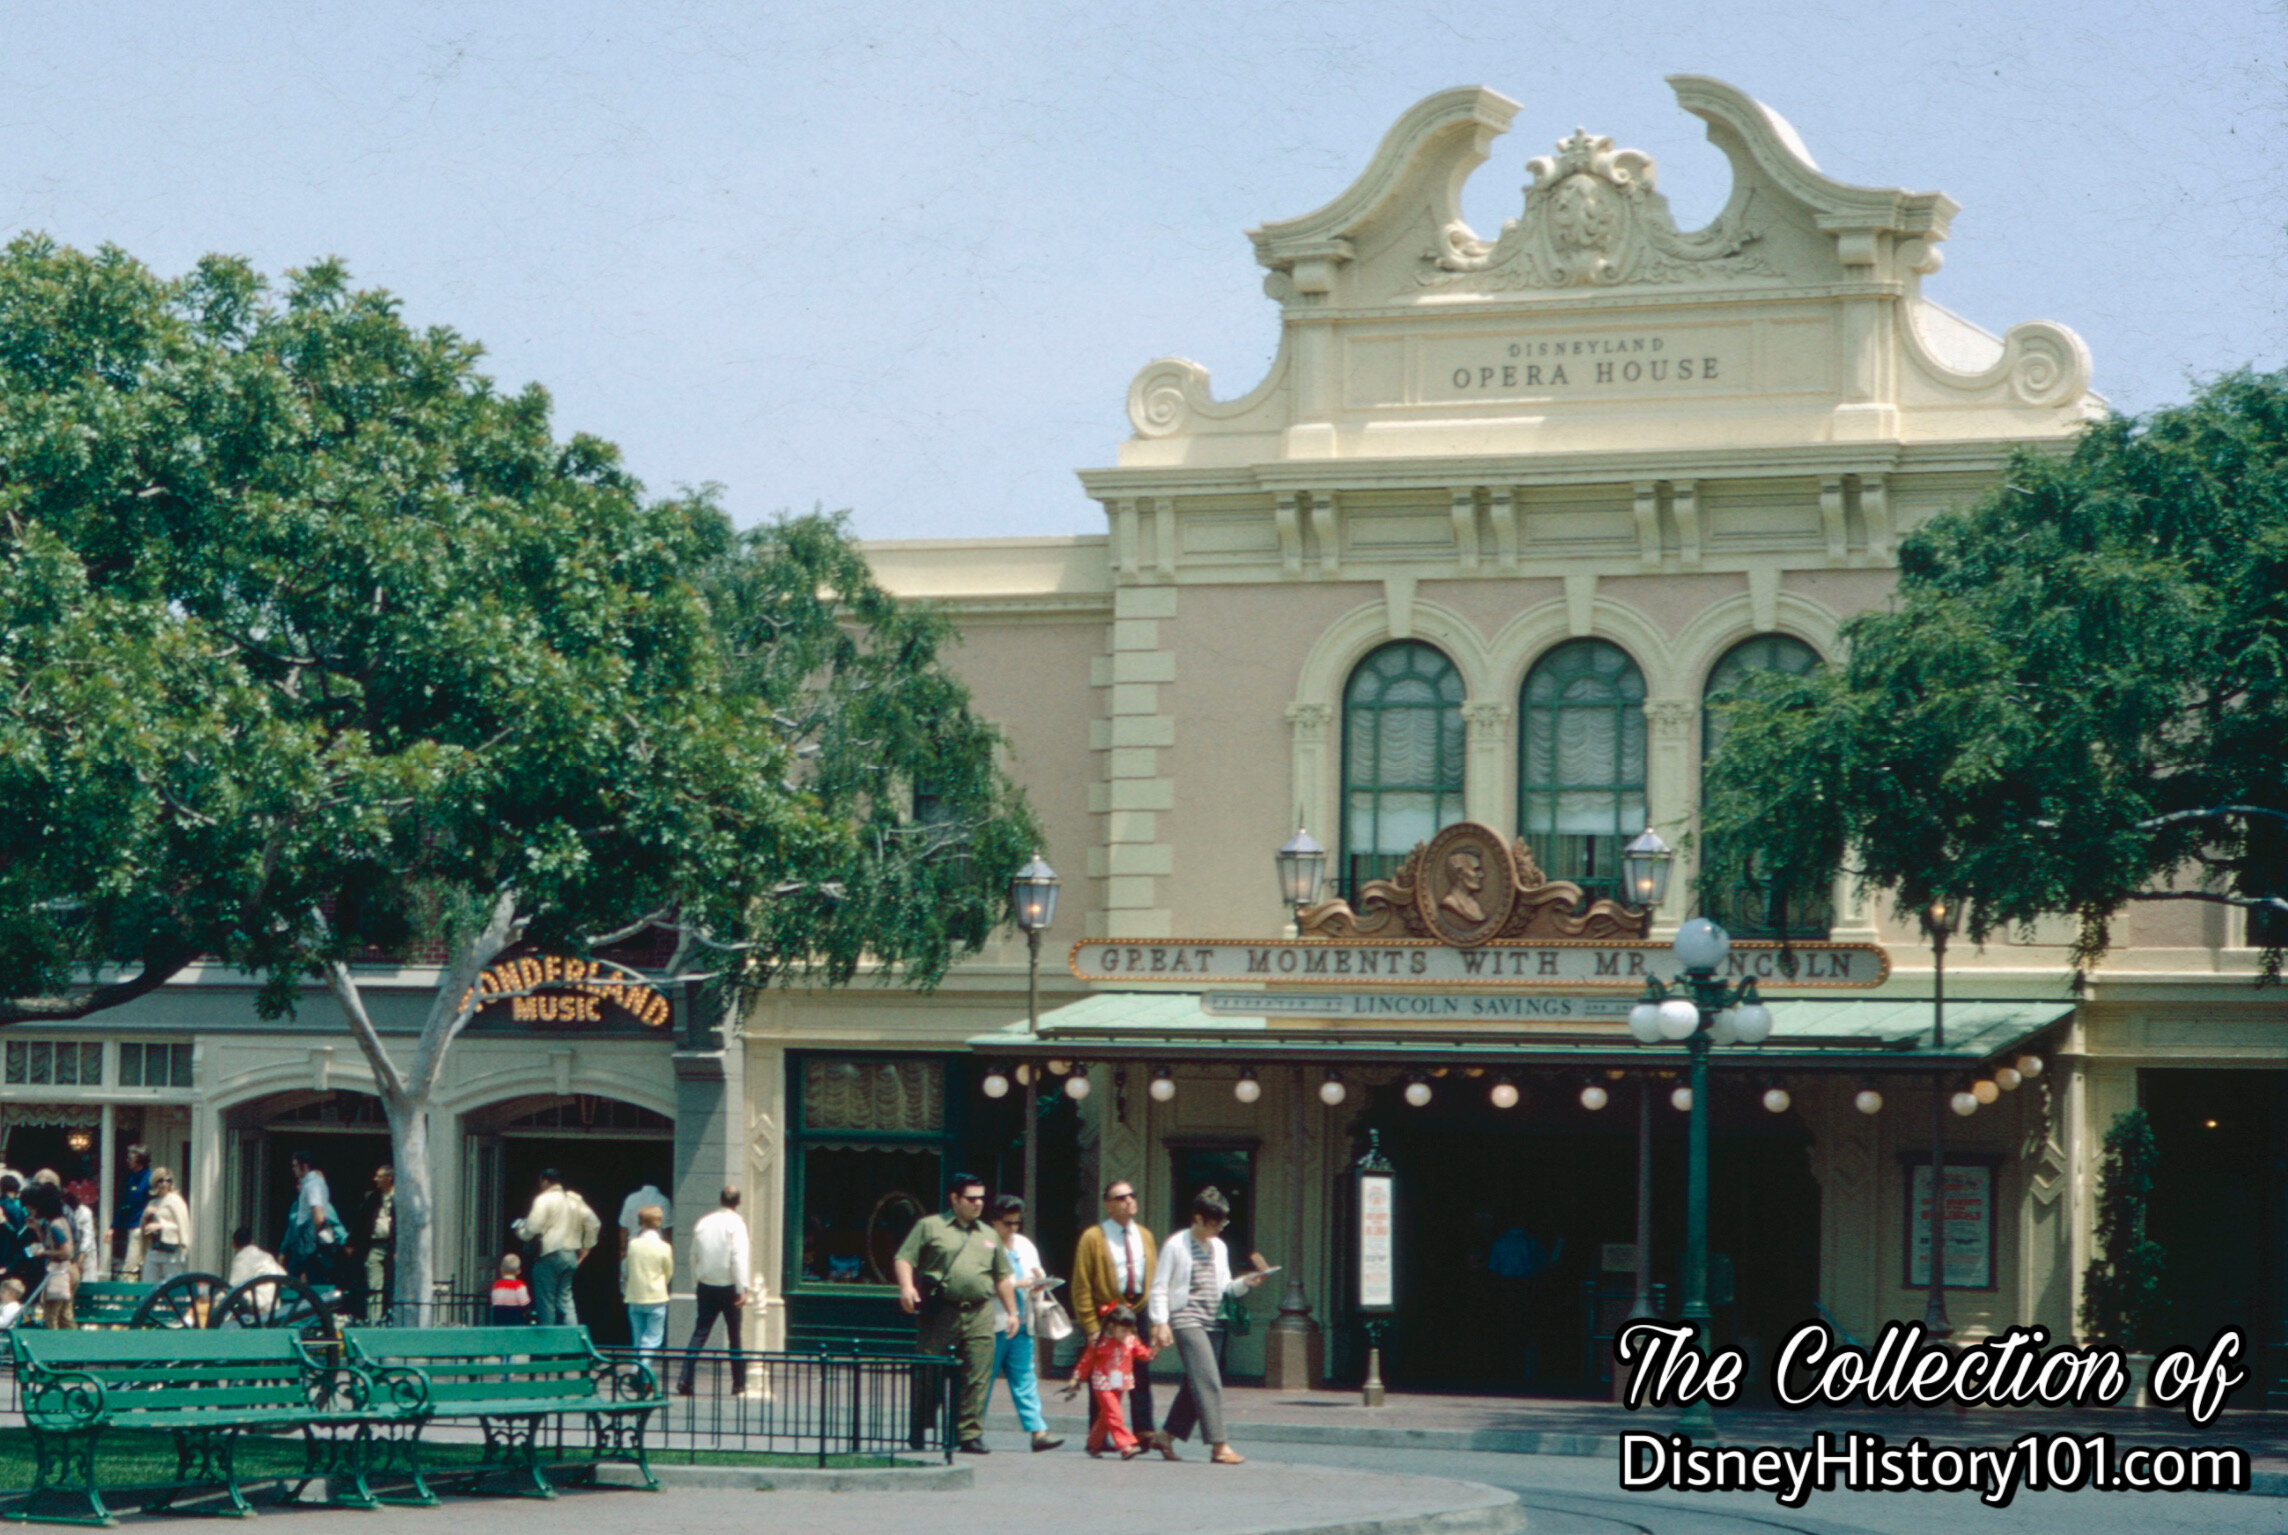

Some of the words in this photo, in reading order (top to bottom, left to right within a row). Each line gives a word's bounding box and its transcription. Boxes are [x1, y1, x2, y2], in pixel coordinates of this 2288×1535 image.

[1508, 338, 1664, 357] DISNEYLAND
[1452, 364, 1570, 389] OPERA
[1595, 358, 1719, 383] HOUSE
[1101, 948, 1215, 973] GREAT
[1246, 949, 1428, 975] MOMENTS
[1461, 950, 1559, 976] WITH
[1595, 951, 1656, 977] MR.
[512, 996, 602, 1022] MUSIC
[1354, 996, 1458, 1014] LINCOLN
[1472, 998, 1573, 1016] SAVINGS
